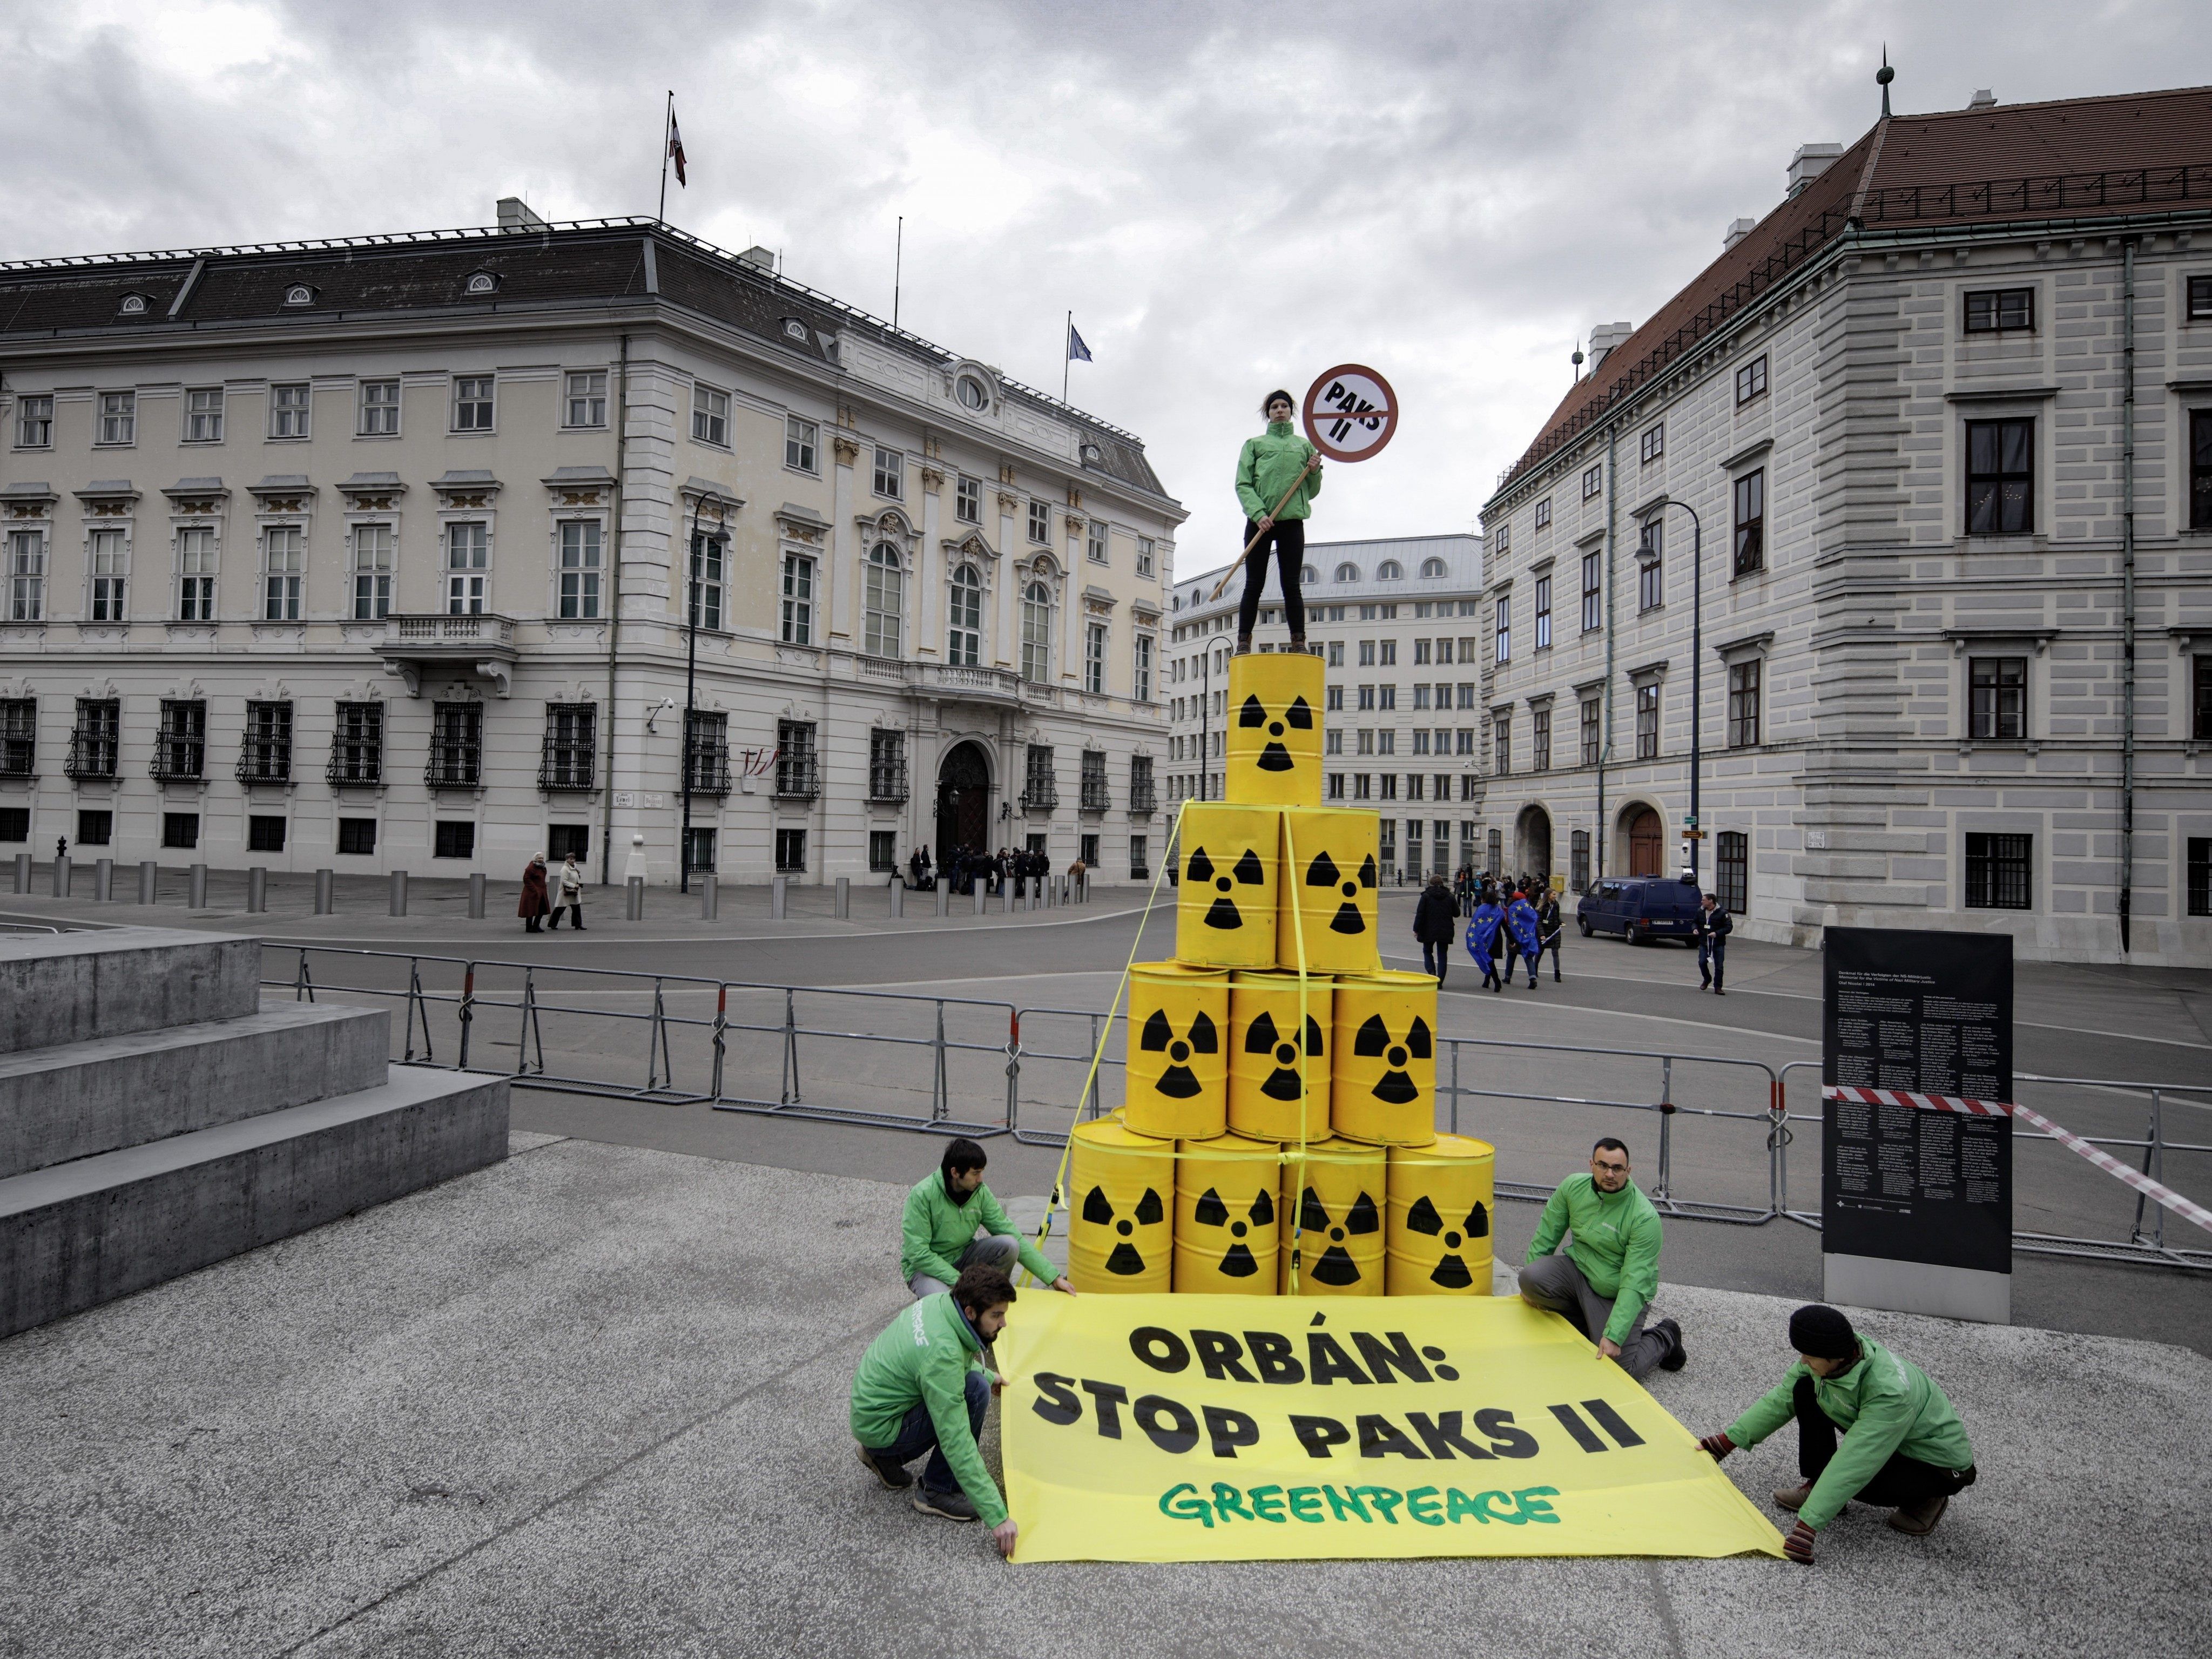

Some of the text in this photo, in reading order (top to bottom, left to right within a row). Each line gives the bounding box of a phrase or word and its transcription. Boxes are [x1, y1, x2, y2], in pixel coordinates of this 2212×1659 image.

[1324, 381, 1384, 430] PAKS
[1328, 418, 1351, 443] II
[1129, 1312, 1459, 1385] ORBÁN:
[1033, 1372, 1645, 1459] STOP PAKS II
[1159, 1482, 1560, 1528] GREENPEACE
